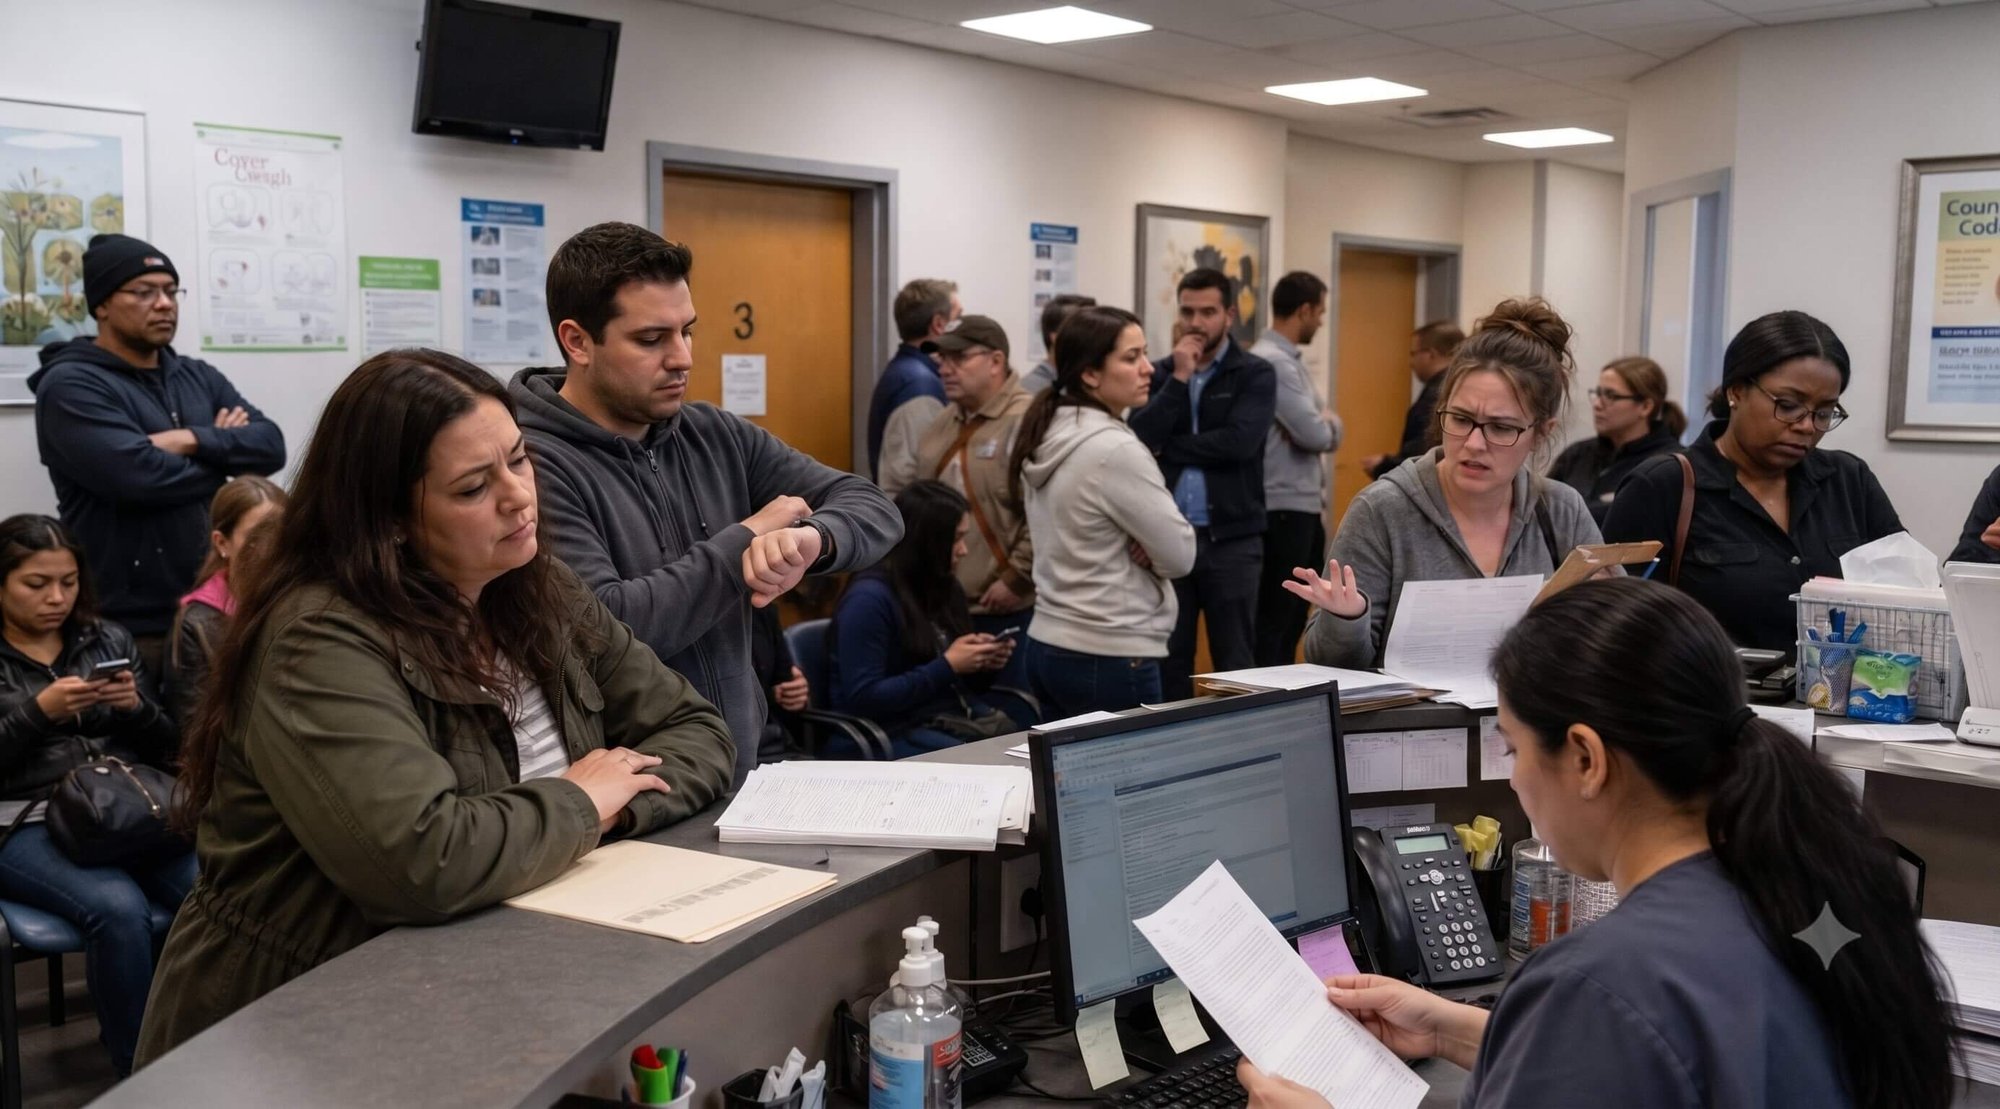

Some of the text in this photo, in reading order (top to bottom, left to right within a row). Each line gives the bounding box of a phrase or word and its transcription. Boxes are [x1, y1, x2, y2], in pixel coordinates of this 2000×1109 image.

[214, 147, 270, 170] Cover
[1946, 200, 1999, 216] Coun
[1959, 216, 2000, 236] Cod
[734, 302, 754, 340] 3
